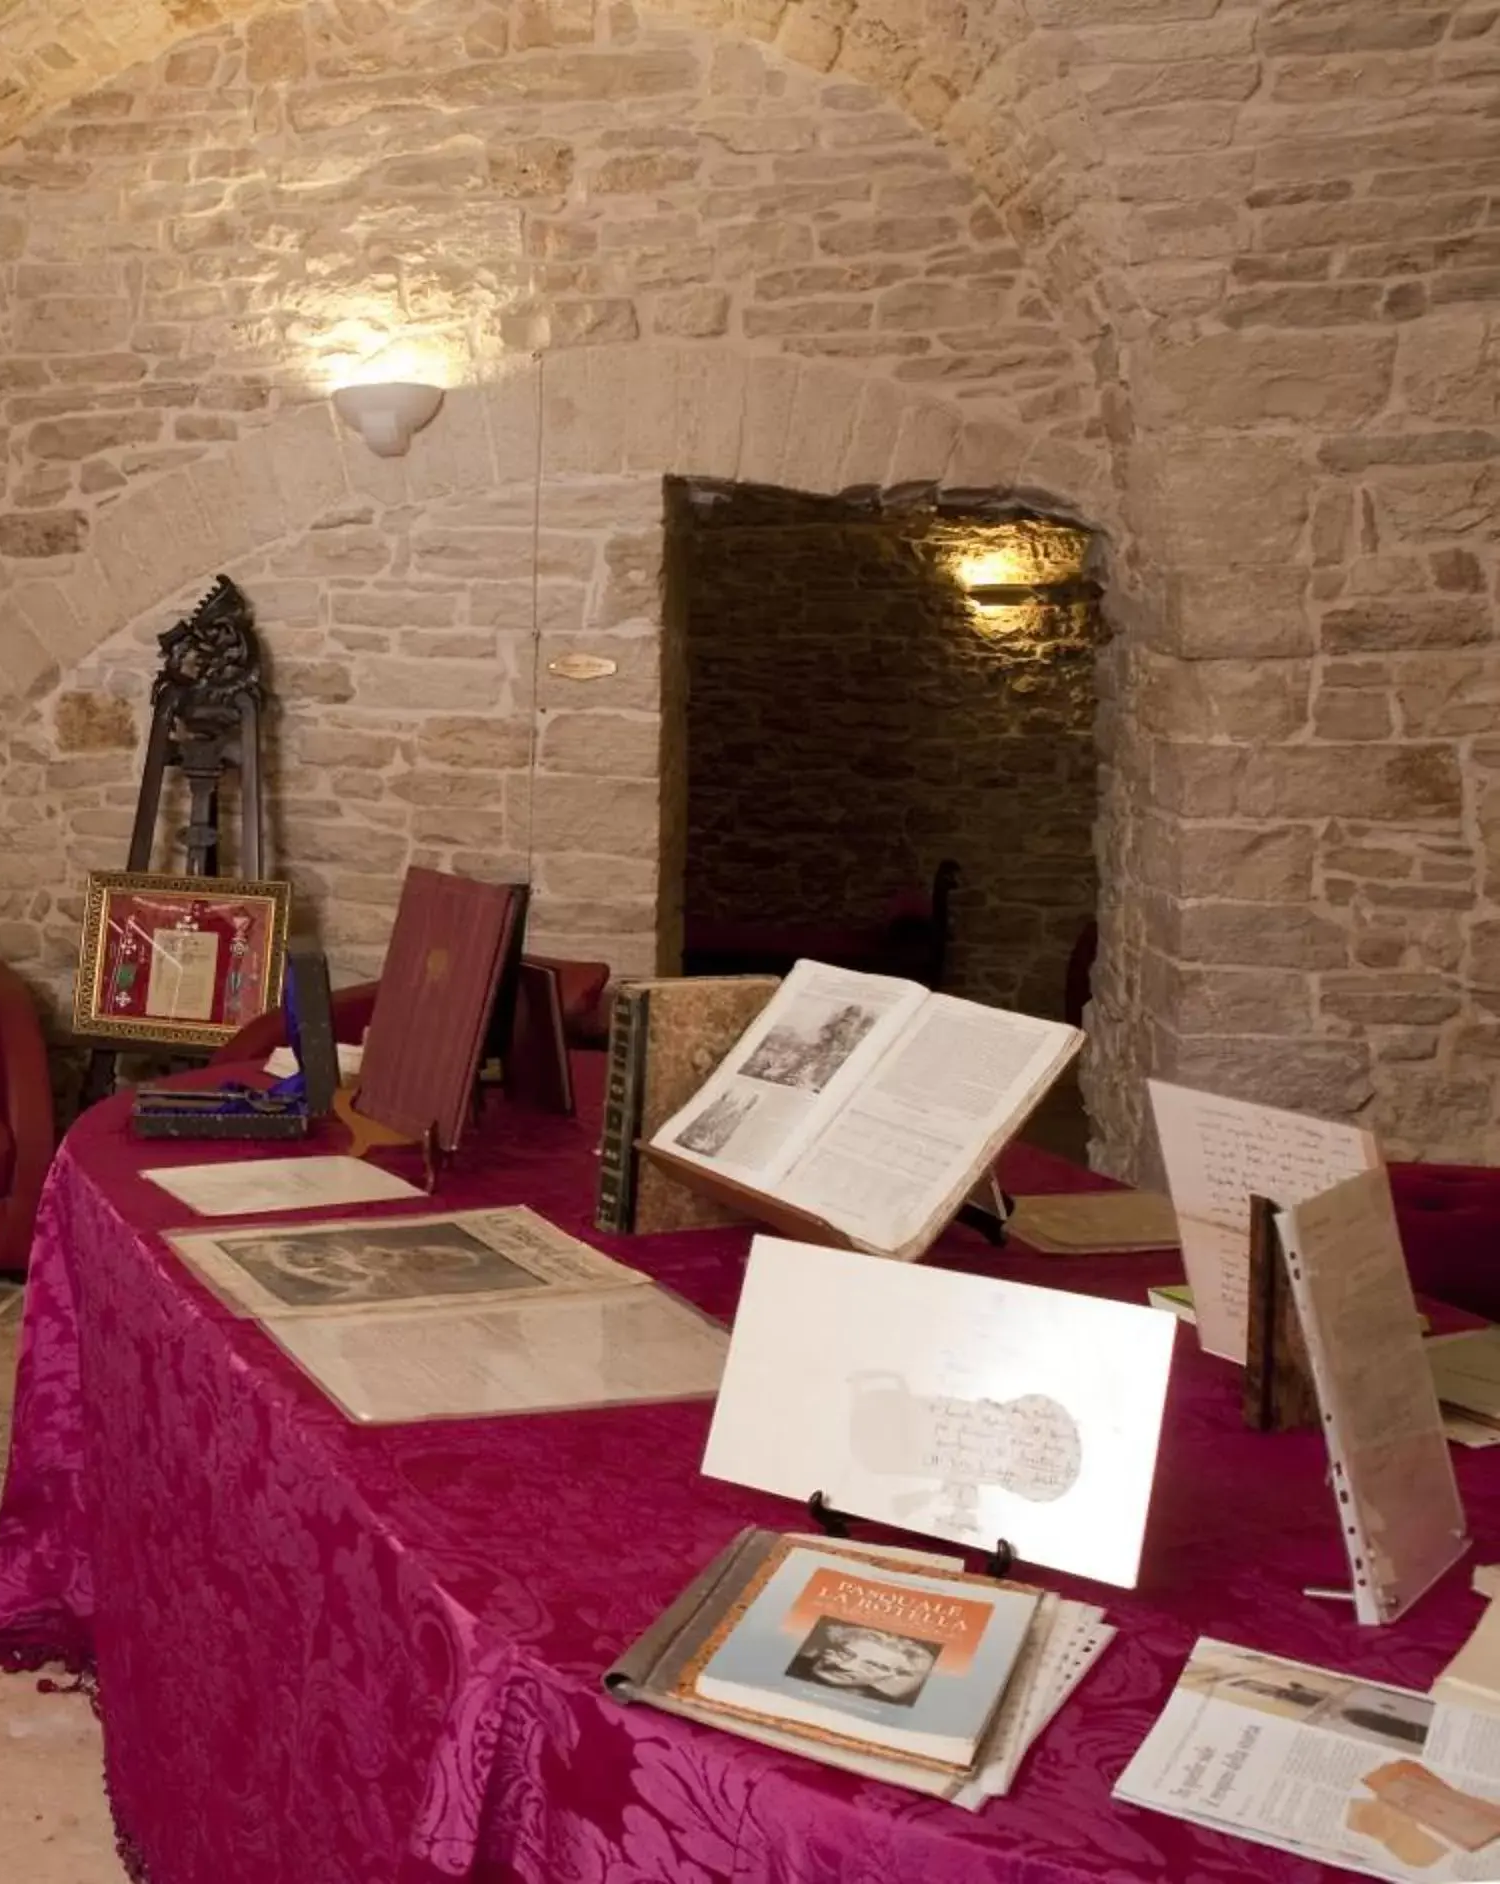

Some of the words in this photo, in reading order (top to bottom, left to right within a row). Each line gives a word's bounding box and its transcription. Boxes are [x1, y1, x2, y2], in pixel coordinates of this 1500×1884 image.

[818, 1586, 848, 1603] LA
[857, 1598, 968, 1632] ROTELLA
[838, 1580, 963, 1617] PASQUALE
